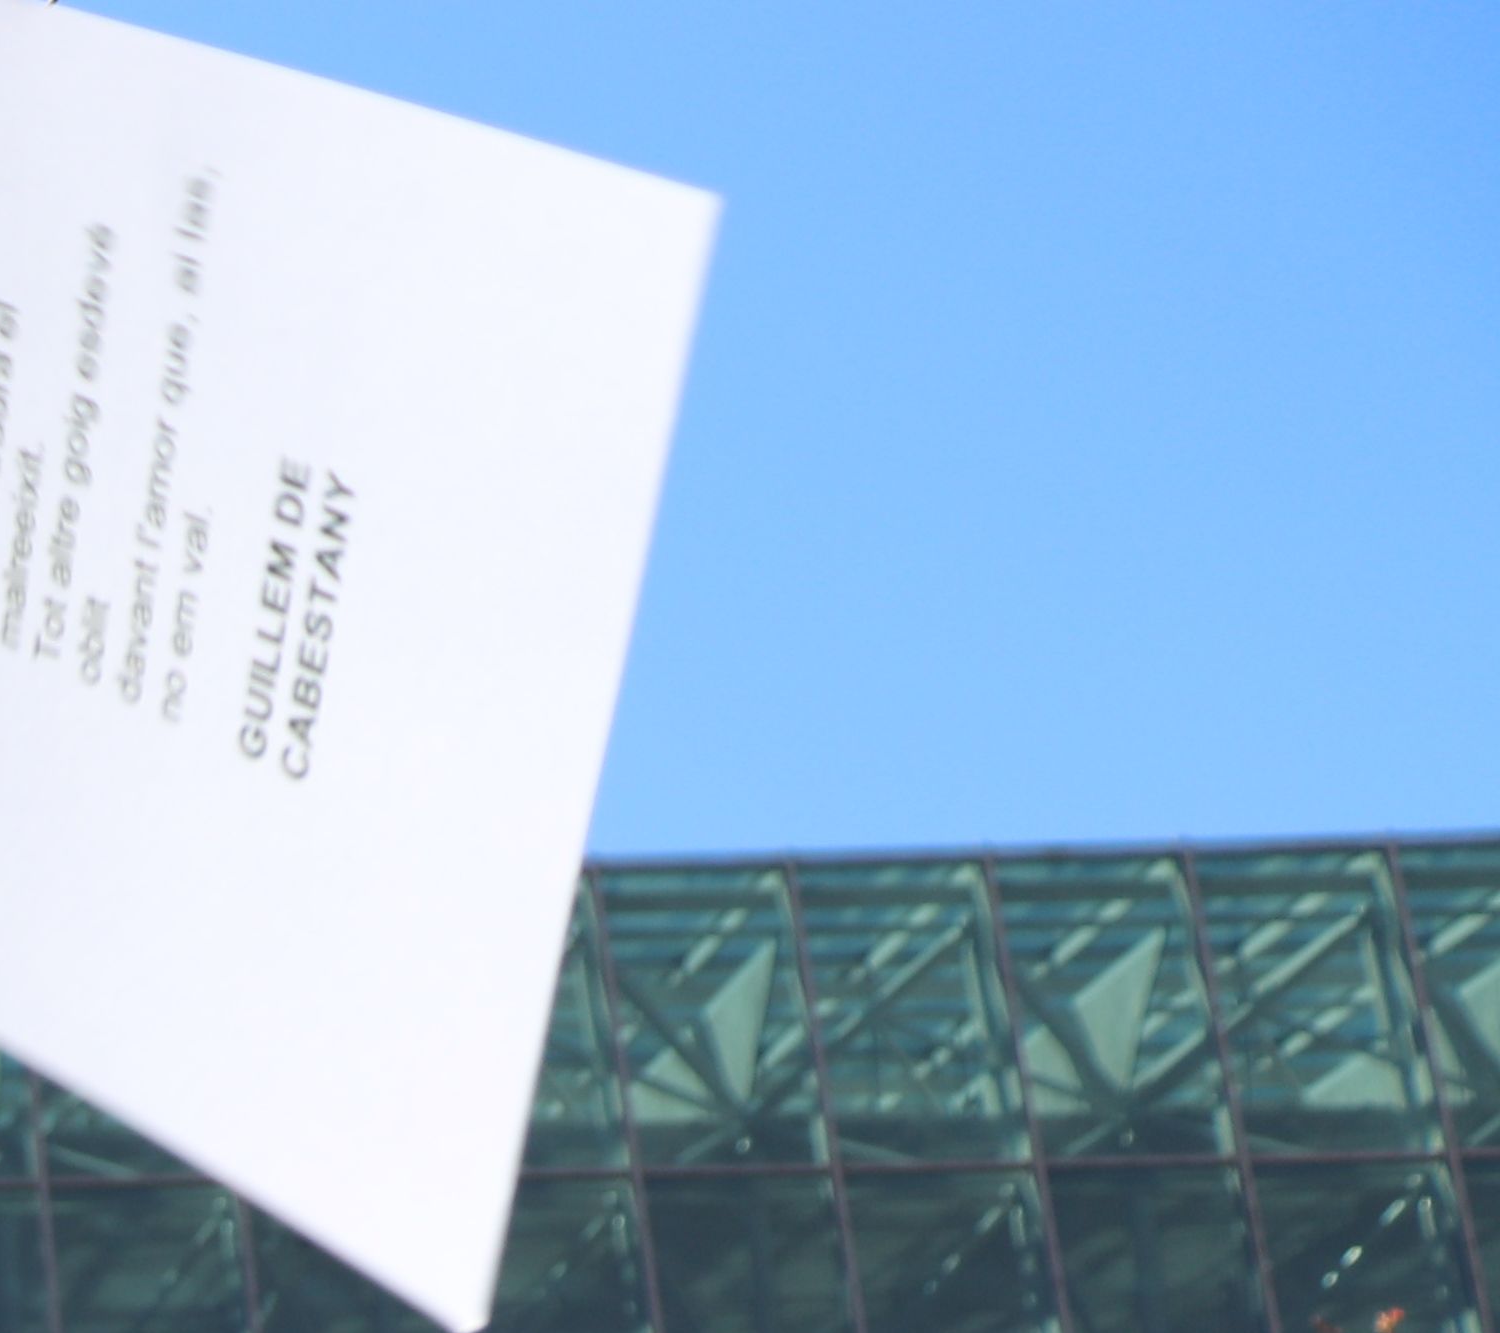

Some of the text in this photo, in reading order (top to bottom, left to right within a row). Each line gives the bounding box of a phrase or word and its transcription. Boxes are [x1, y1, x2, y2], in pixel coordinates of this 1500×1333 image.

[238, 459, 309, 760] GUILLEM DE
[280, 471, 353, 780] CABESTANY
